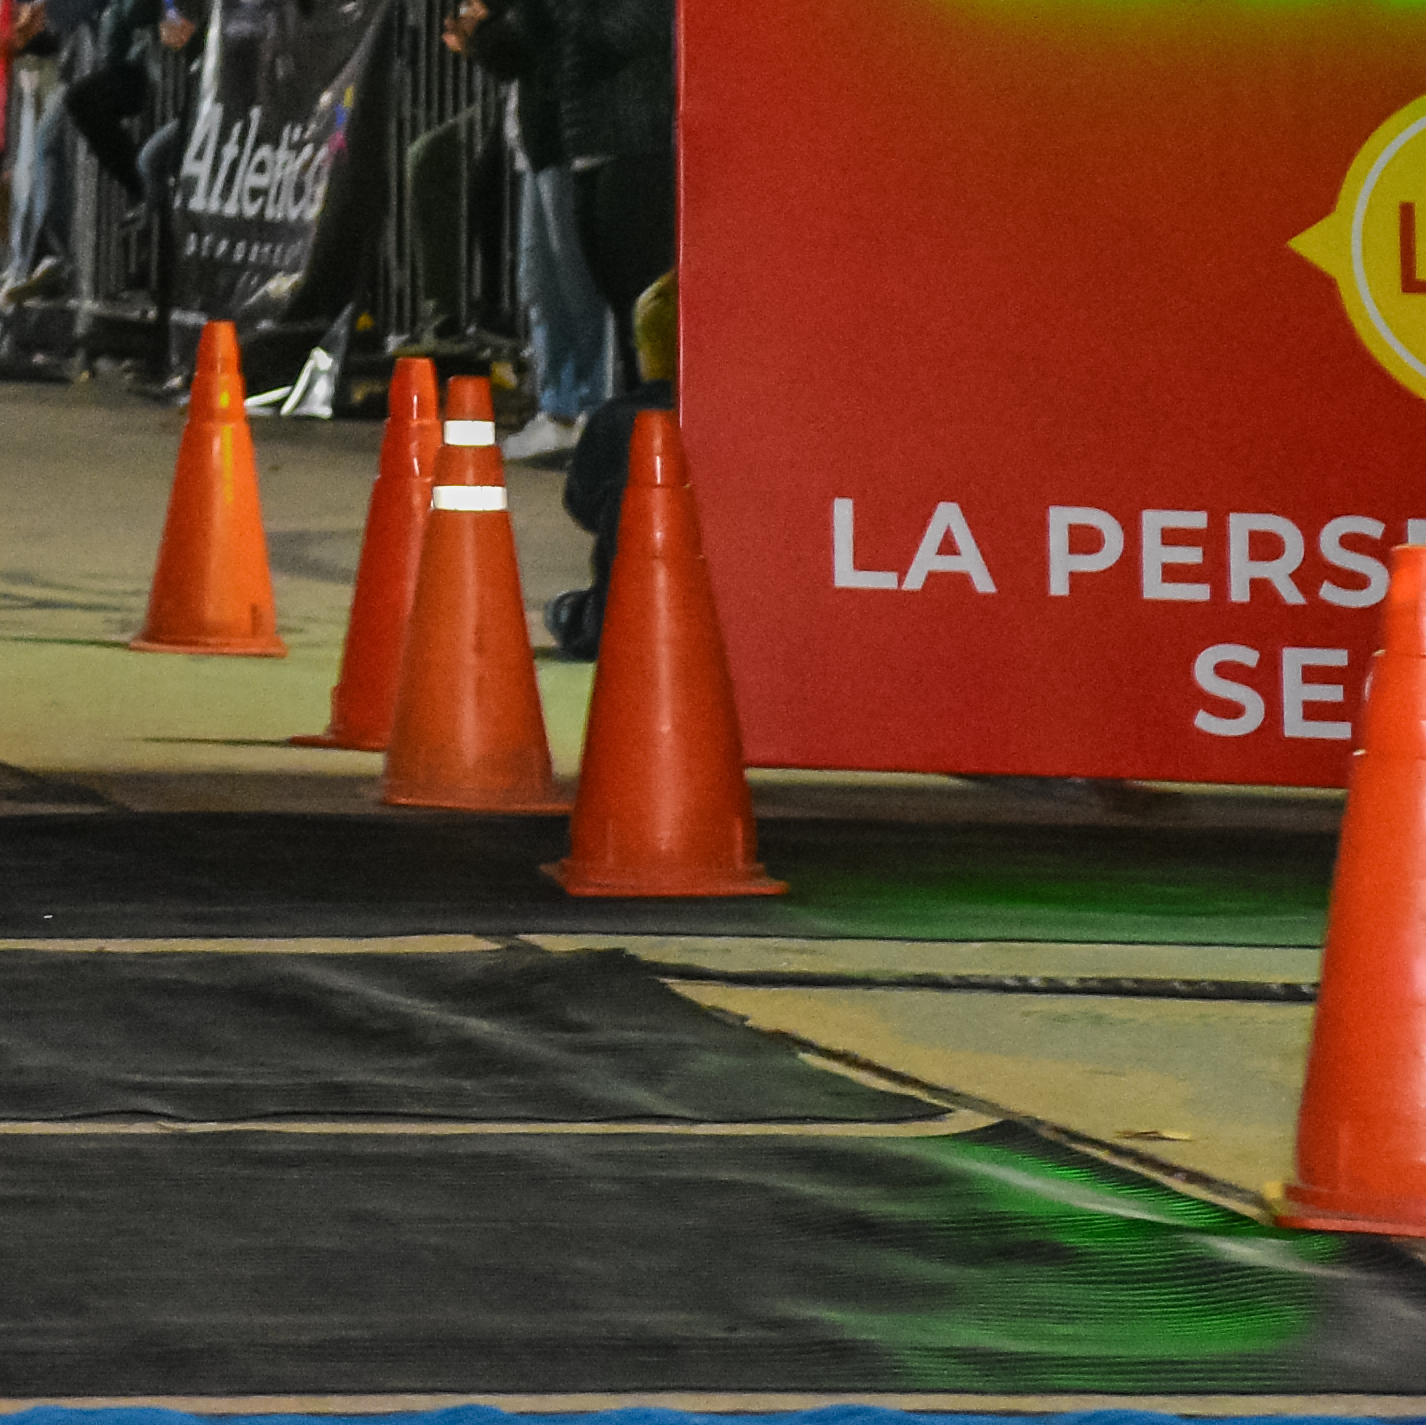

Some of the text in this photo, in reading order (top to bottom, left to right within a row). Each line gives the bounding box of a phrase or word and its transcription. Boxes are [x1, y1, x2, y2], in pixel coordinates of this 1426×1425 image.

[832, 496, 1426, 609] LA PERS
[1192, 642, 1354, 740] SE
